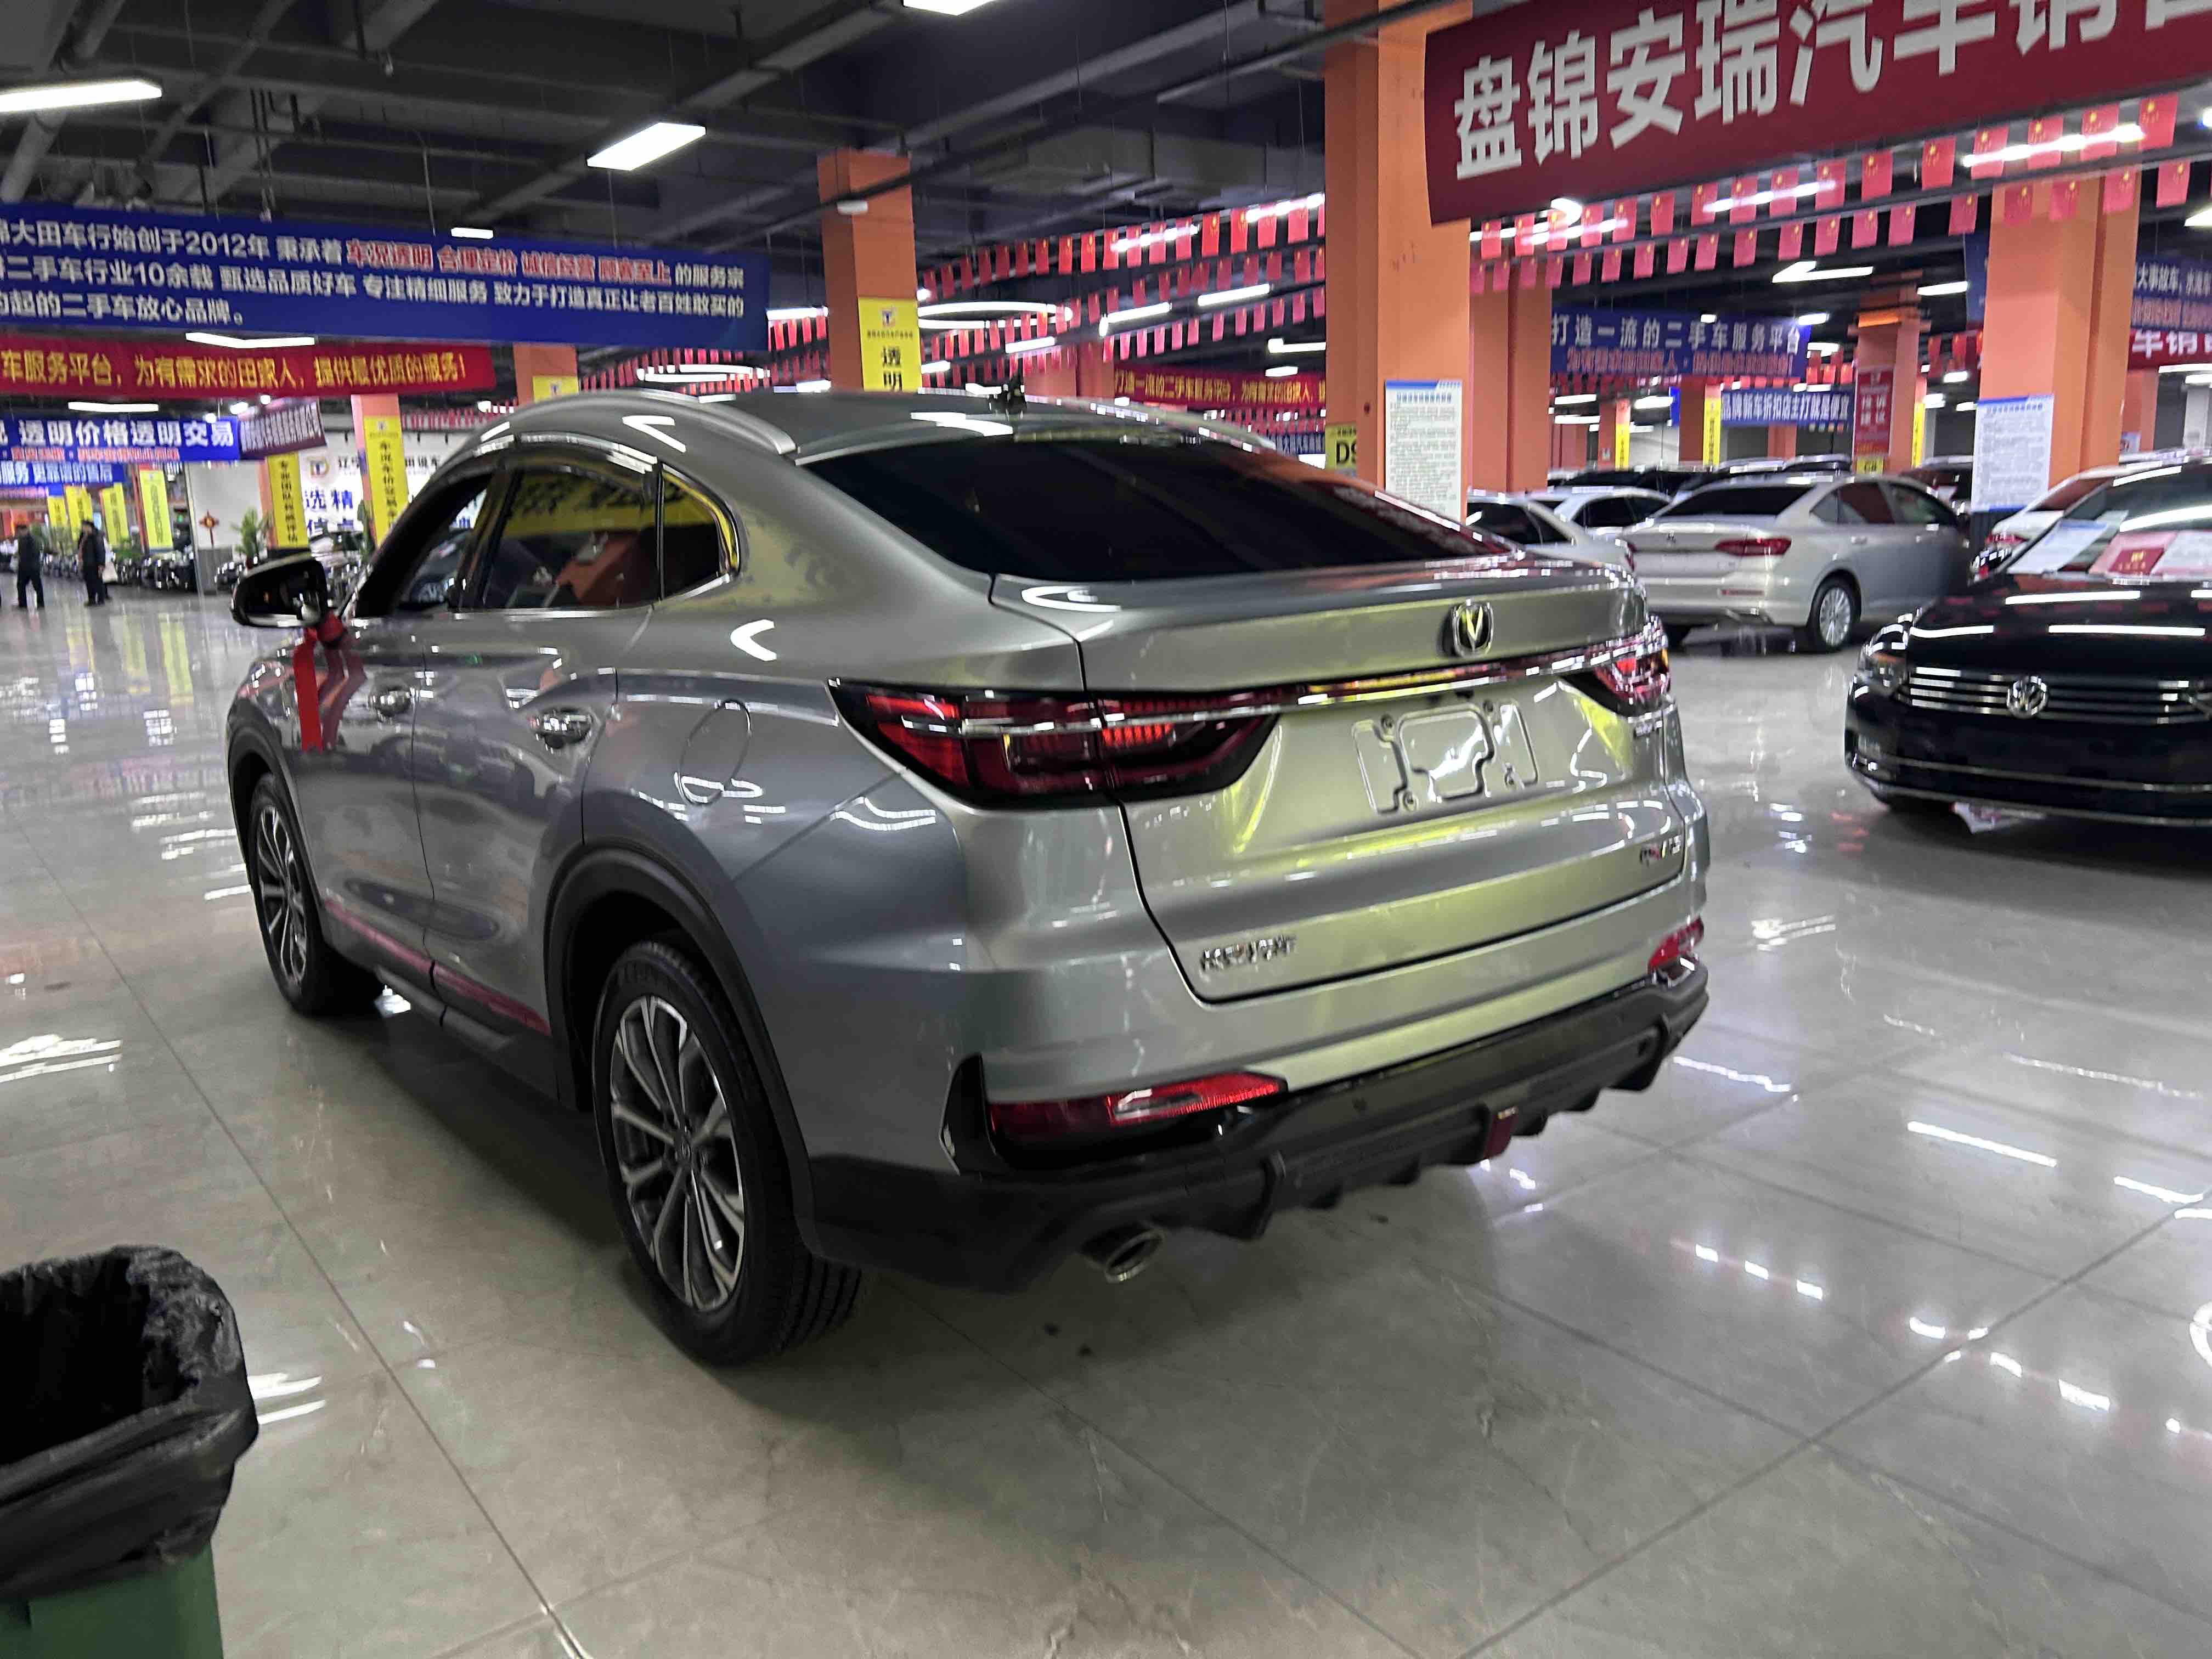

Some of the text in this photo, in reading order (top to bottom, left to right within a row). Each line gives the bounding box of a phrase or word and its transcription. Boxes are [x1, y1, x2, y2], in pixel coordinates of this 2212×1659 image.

[1454, 0, 2212, 180] 盘锦安瑞汽车
[0, 254, 215, 290] 二手车行业10余载
